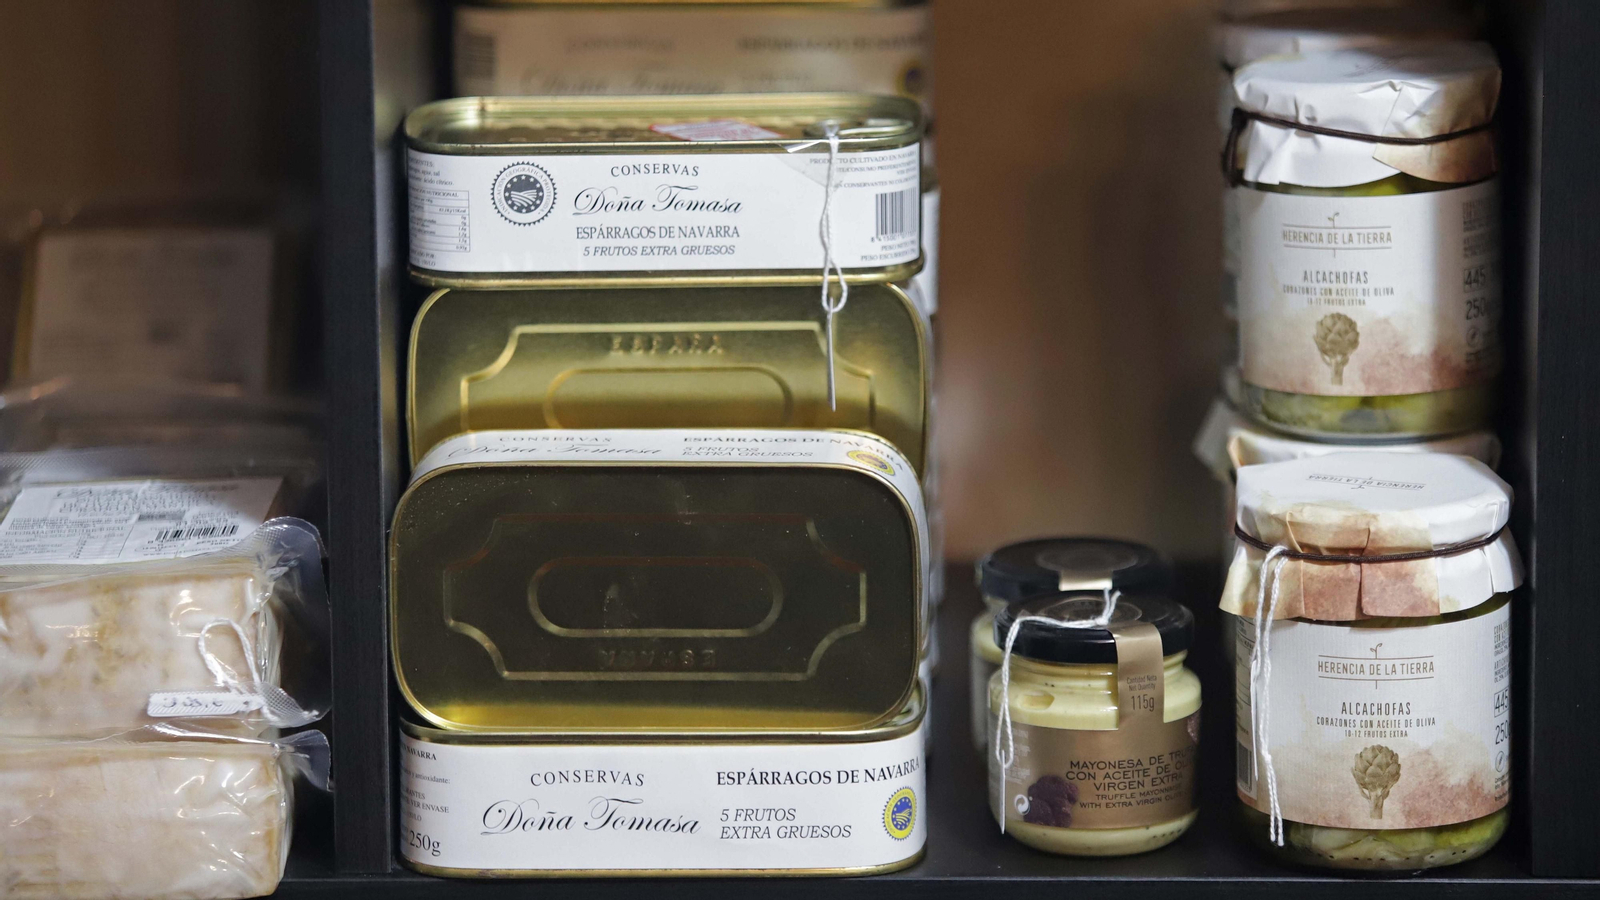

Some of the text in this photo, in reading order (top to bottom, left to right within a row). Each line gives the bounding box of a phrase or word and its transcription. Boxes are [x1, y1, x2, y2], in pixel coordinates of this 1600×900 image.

[505, 166, 543, 179] GEOGRÁFICA
[611, 164, 699, 177] CONSERVAS
[572, 184, 743, 215] Doña Tomasa
[576, 224, 740, 240] ESPÁRRAGOS DE NAVARRA
[1282, 230, 1392, 245] HERENCIA DE LA TIERRA
[583, 245, 735, 256] 5 FRUTOS EXTRA GRUESOS
[1303, 270, 1369, 285] ALCACHOFAS
[1283, 284, 1317, 296] CORAZONES
[1336, 286, 1359, 297] ACEITE
[1374, 286, 1394, 296] OLIVA
[499, 436, 612, 444] CONSERVAS
[1318, 661, 1434, 676] HERENCIA DE LA TIERRA
[1131, 694, 1155, 712] 115g
[1341, 702, 1411, 716] ALCACHOFAS
[1316, 716, 1436, 729] CORAZONES CON ACEITE DE OLIVA
[1344, 729, 1408, 738] 10-12 FRUTOS EXTRA
[1070, 758, 1144, 770] MAYONESA
[1149, 754, 1165, 766] DE
[717, 756, 920, 785] ESPÁRRAGOS DE NAVARRA
[1065, 771, 1096, 781] CON
[1103, 768, 1150, 781] ACEITE
[1156, 764, 1171, 776] DE
[530, 770, 645, 787] CONSERVAS
[1094, 772, 1183, 791] VIRGEN EXTRA
[1095, 792, 1136, 801] TRUFFLE
[1105, 801, 1133, 809] EXTRA
[1136, 797, 1162, 807] VIRGIN
[422, 803, 449, 813] ENVASE
[720, 808, 797, 822] 5 FRUTOS
[480, 796, 702, 836] Doña Tomasa
[720, 825, 852, 839] EXTRA GRUESOS
[410, 830, 442, 857] 250g
